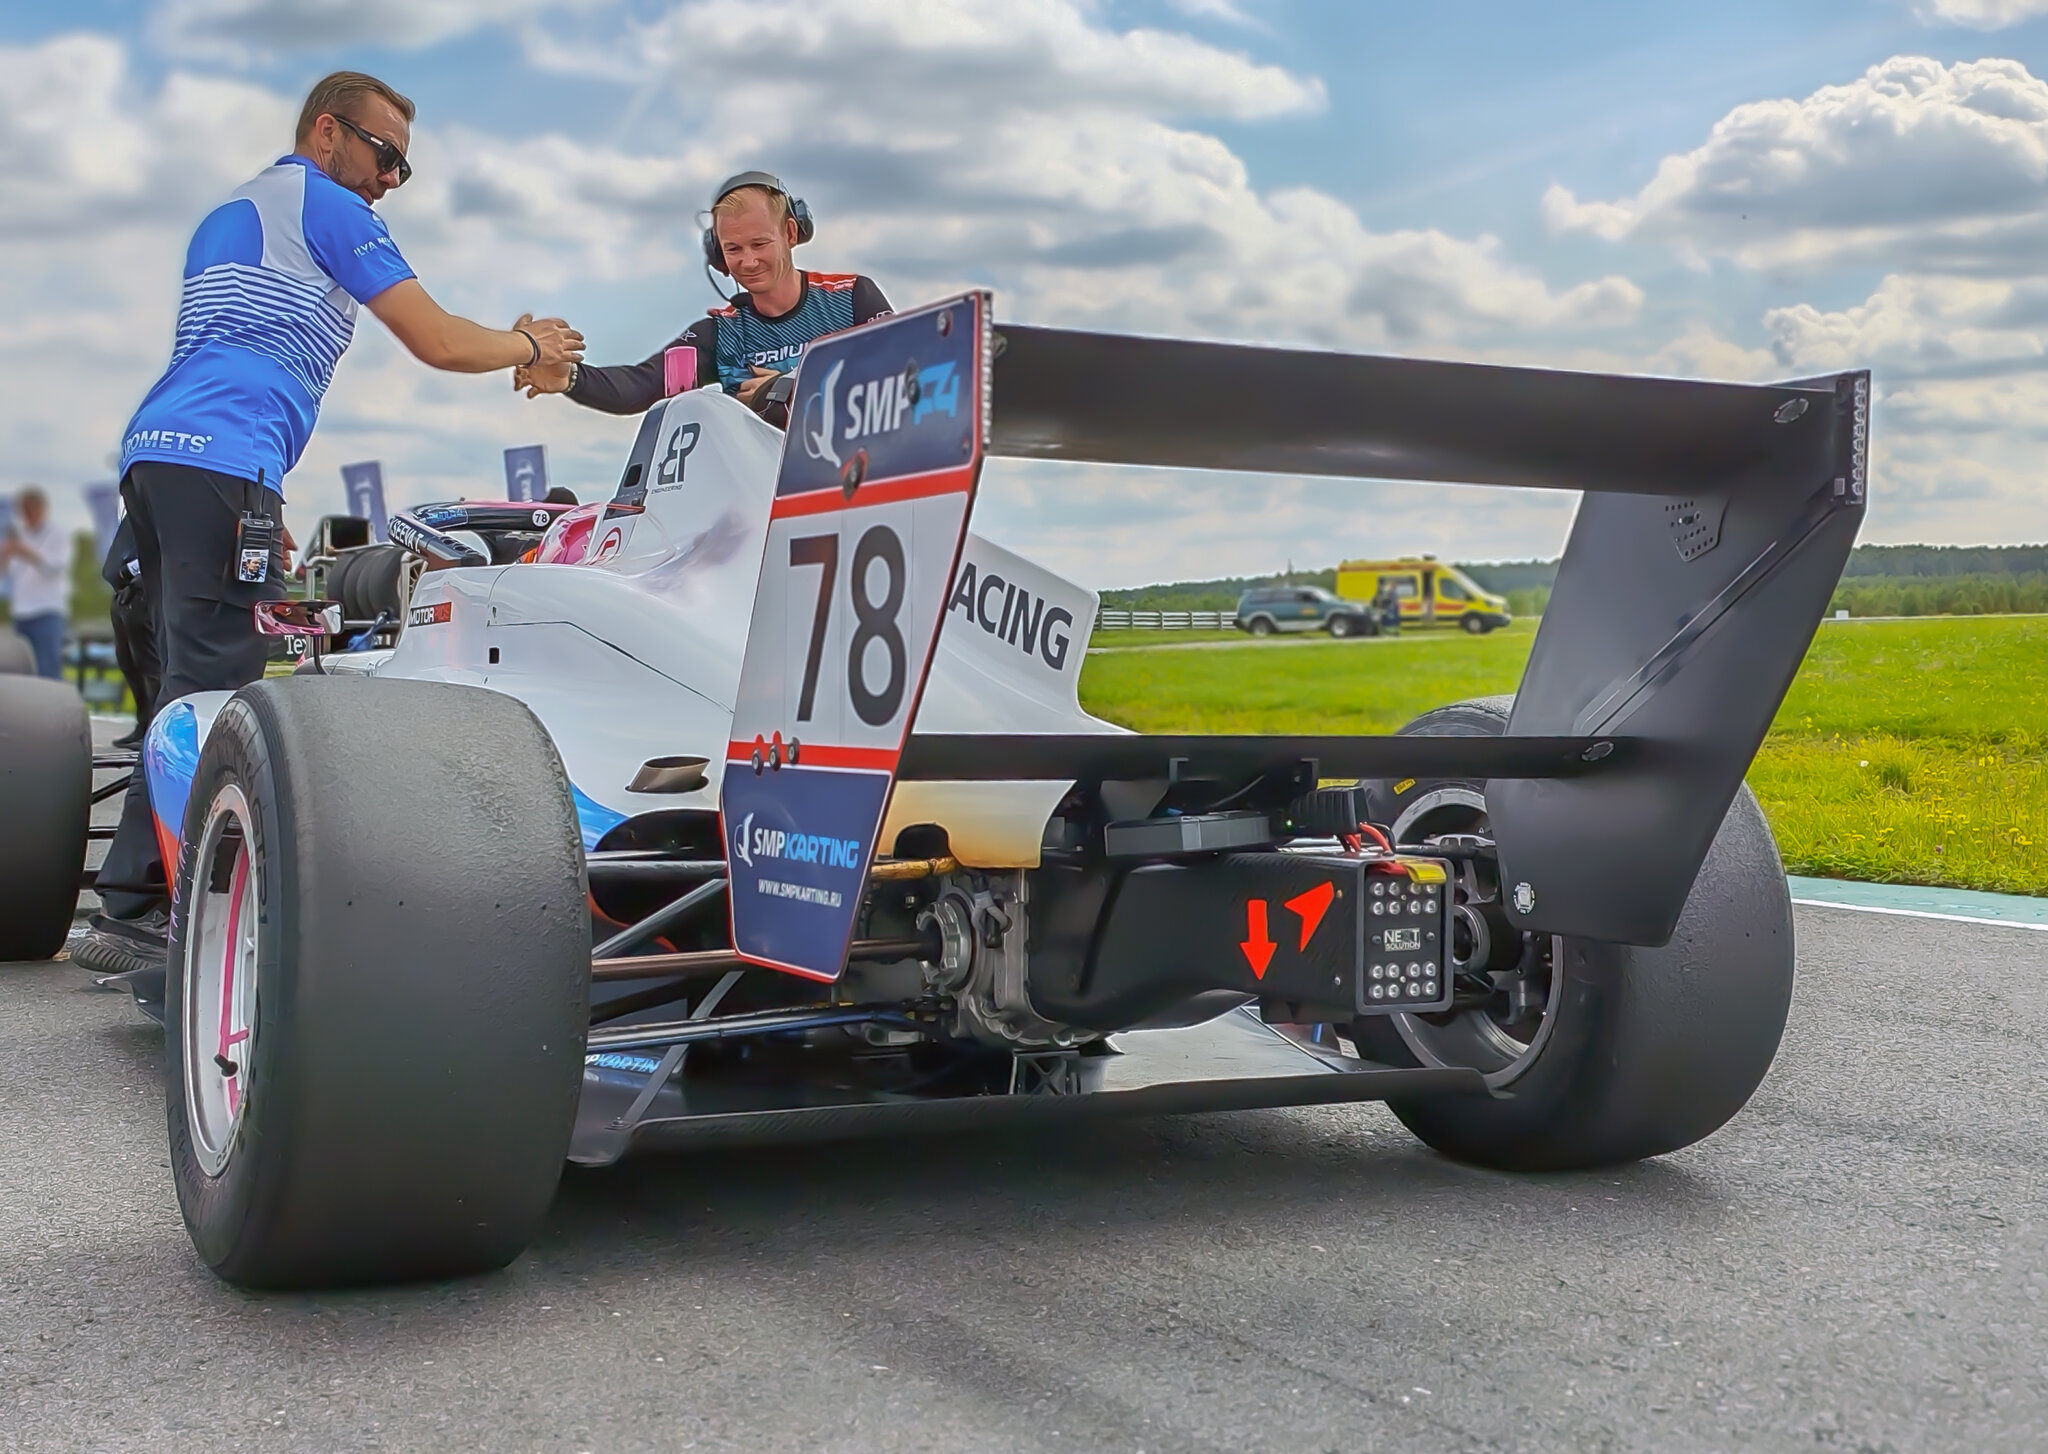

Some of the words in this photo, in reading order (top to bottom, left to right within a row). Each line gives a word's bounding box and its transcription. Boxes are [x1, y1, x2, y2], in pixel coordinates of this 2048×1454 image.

[353, 241, 378, 258] ILYA
[534, 513, 547, 529] 78
[789, 523, 907, 727] 78
[758, 878, 842, 908] WWW.SMPKARTING.RU
